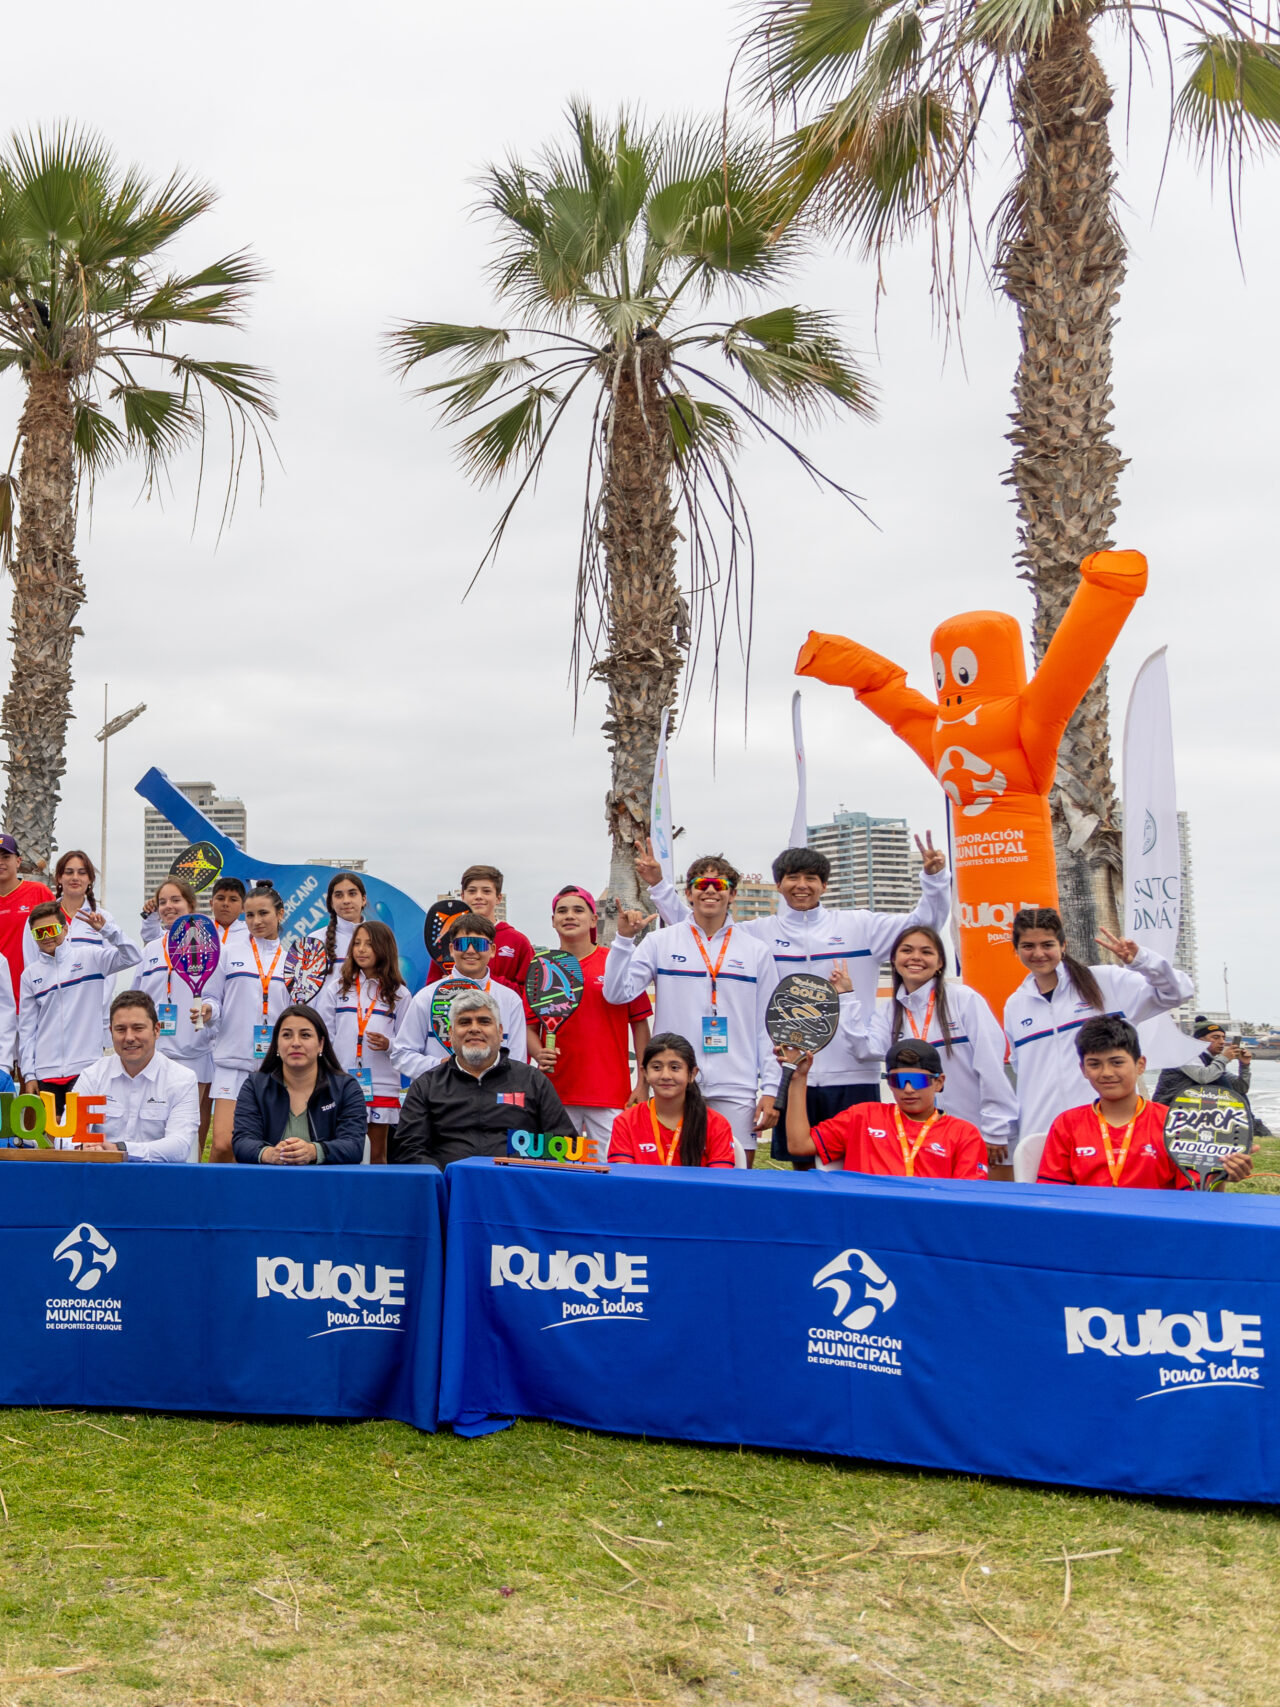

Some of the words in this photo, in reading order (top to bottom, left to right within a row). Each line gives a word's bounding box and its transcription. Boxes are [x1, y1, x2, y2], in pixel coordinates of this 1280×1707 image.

[671, 954, 687, 963] TD
[789, 985, 827, 1002] GOLD
[1165, 1107, 1250, 1136] BLACK
[507, 1129, 599, 1163] IQUIQUE
[639, 1143, 657, 1153] TD
[1075, 1146, 1096, 1157] TD
[1169, 1140, 1245, 1156] NOLOOK
[256, 1256, 406, 1309] IQUIQUE
[490, 1244, 650, 1299] IQUIQUE
[45, 1297, 122, 1309] CORPORACIÓN
[562, 1301, 600, 1319] para
[601, 1295, 644, 1315] todos
[45, 1309, 122, 1323] MUNICIPAL
[327, 1310, 360, 1327] para
[361, 1306, 401, 1325] todos
[808, 1327, 902, 1351] CORPORACIÓN
[1064, 1306, 1265, 1363] IQUIQUE
[807, 1340, 902, 1366] MUNICIPAL
[807, 1355, 818, 1364] DE
[818, 1357, 857, 1368] DEPORTES
[857, 1362, 868, 1370] DE
[868, 1364, 902, 1376] IQUIQUE
[1159, 1367, 1206, 1386] para
[1207, 1358, 1260, 1380] todos
